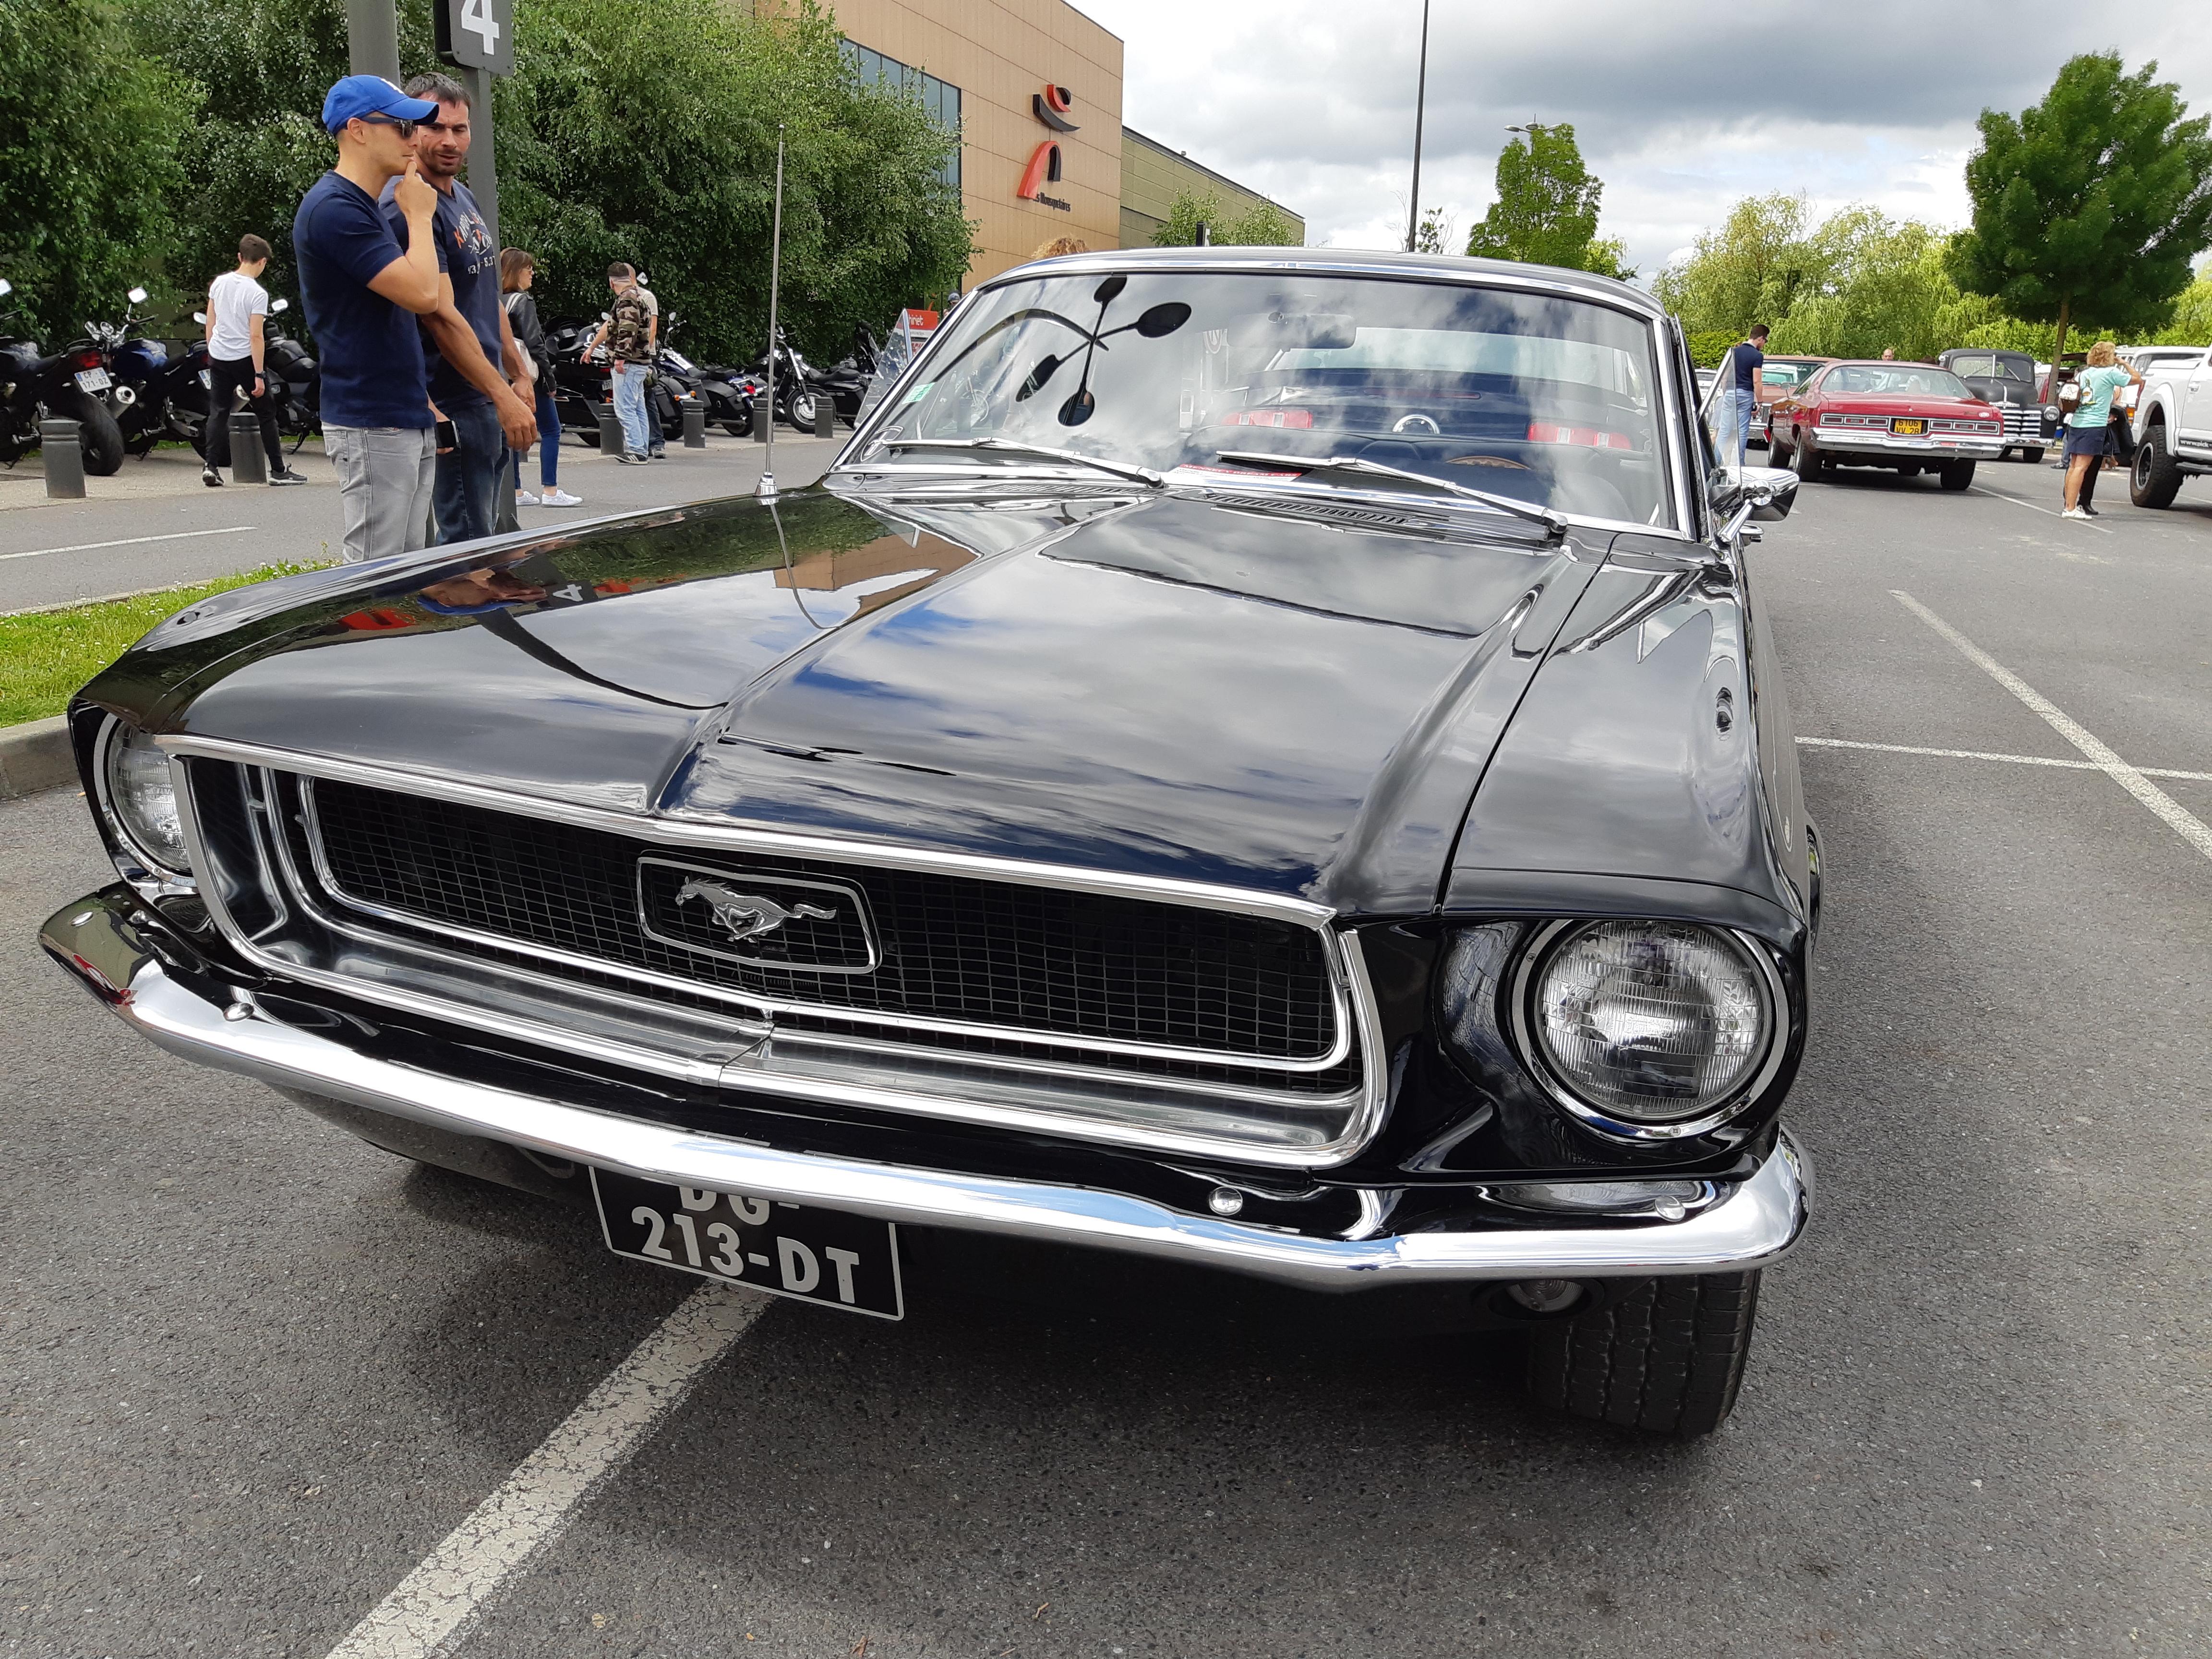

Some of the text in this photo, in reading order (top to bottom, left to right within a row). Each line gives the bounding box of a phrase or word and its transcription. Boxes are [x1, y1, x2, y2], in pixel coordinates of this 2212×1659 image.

[461, 0, 499, 55] 4
[908, 314, 924, 326] hiriet
[82, 377, 108, 389] 171-DZ
[631, 1206, 860, 1304] 213-DT
